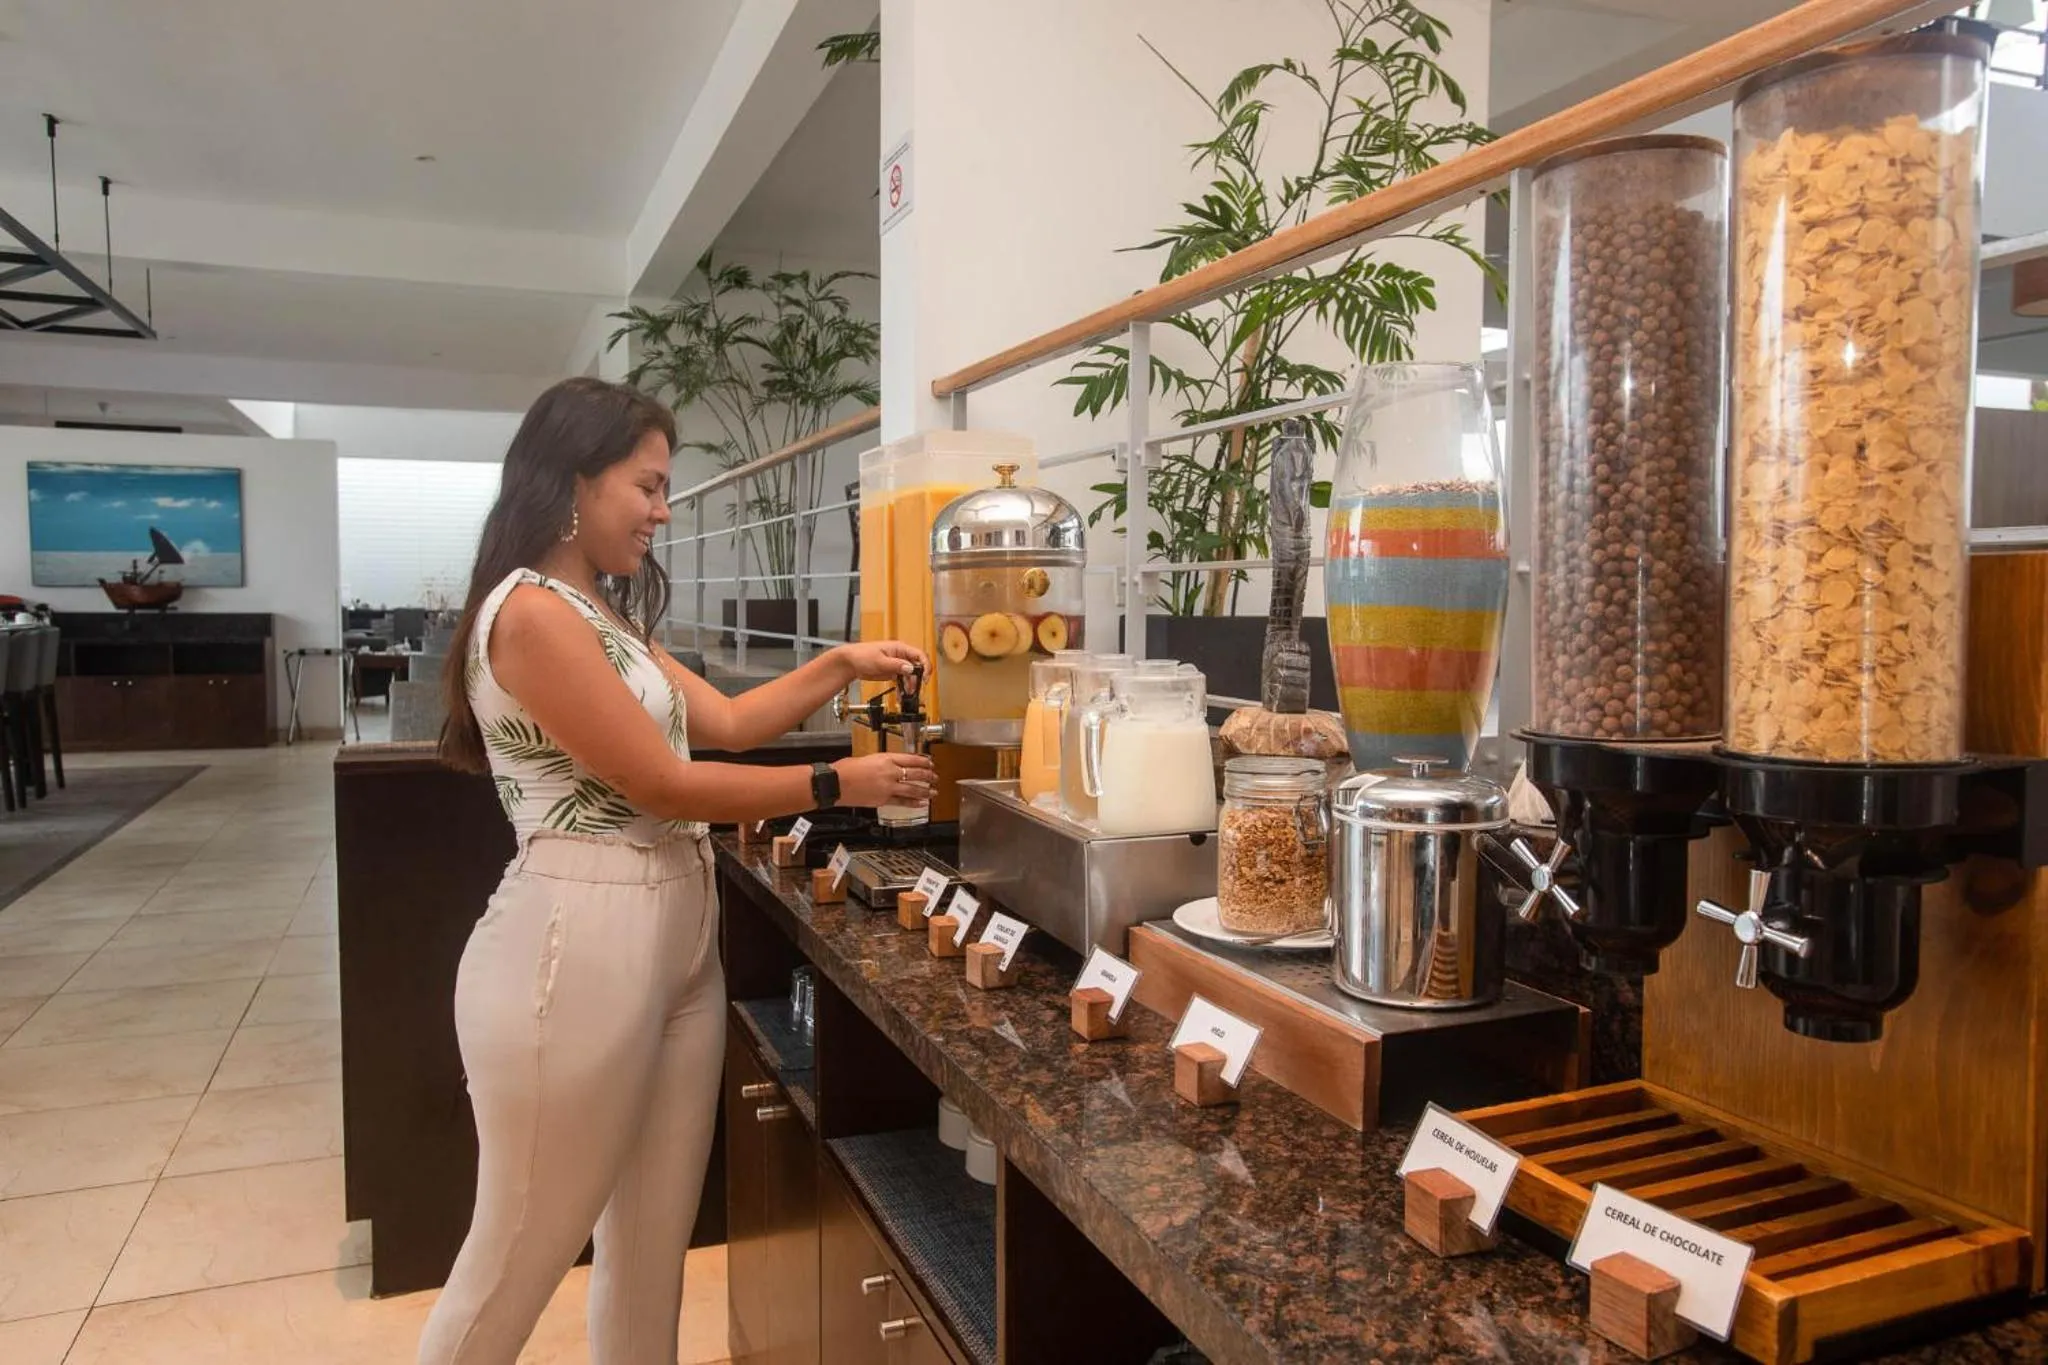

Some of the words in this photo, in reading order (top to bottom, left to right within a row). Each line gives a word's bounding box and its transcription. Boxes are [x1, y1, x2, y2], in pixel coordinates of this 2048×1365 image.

[1431, 1128, 1454, 1148] CEREAL
[1455, 1141, 1465, 1153] DE
[1604, 1206, 1641, 1230] CEREAL
[1643, 1223, 1658, 1237] DE
[1659, 1230, 1725, 1266] CHOCOLATE
